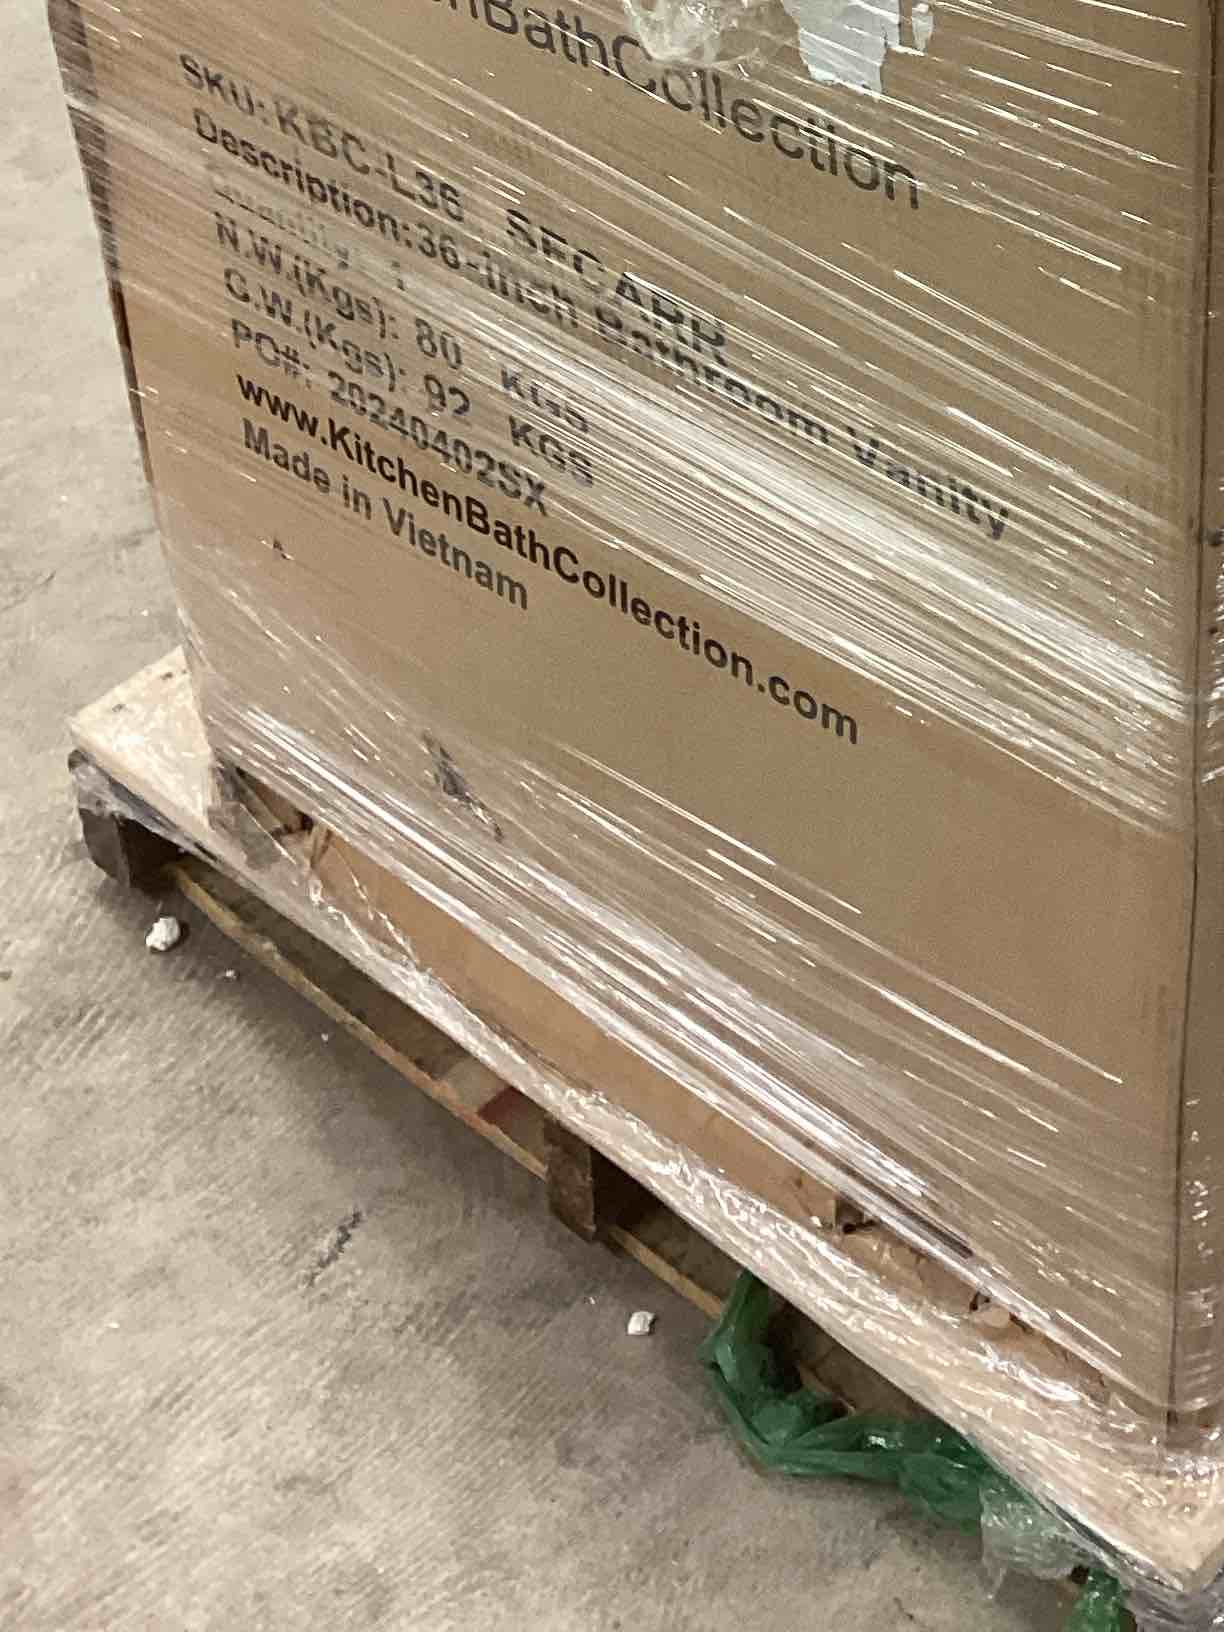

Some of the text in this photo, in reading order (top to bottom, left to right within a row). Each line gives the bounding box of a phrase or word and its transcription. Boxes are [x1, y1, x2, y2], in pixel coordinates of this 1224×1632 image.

[415, 317, 463, 370] 80
[424, 373, 471, 417] 92
[236, 373, 858, 745] www.KitchenBathCollection.com
[242, 417, 529, 611] Made in Vietnam
